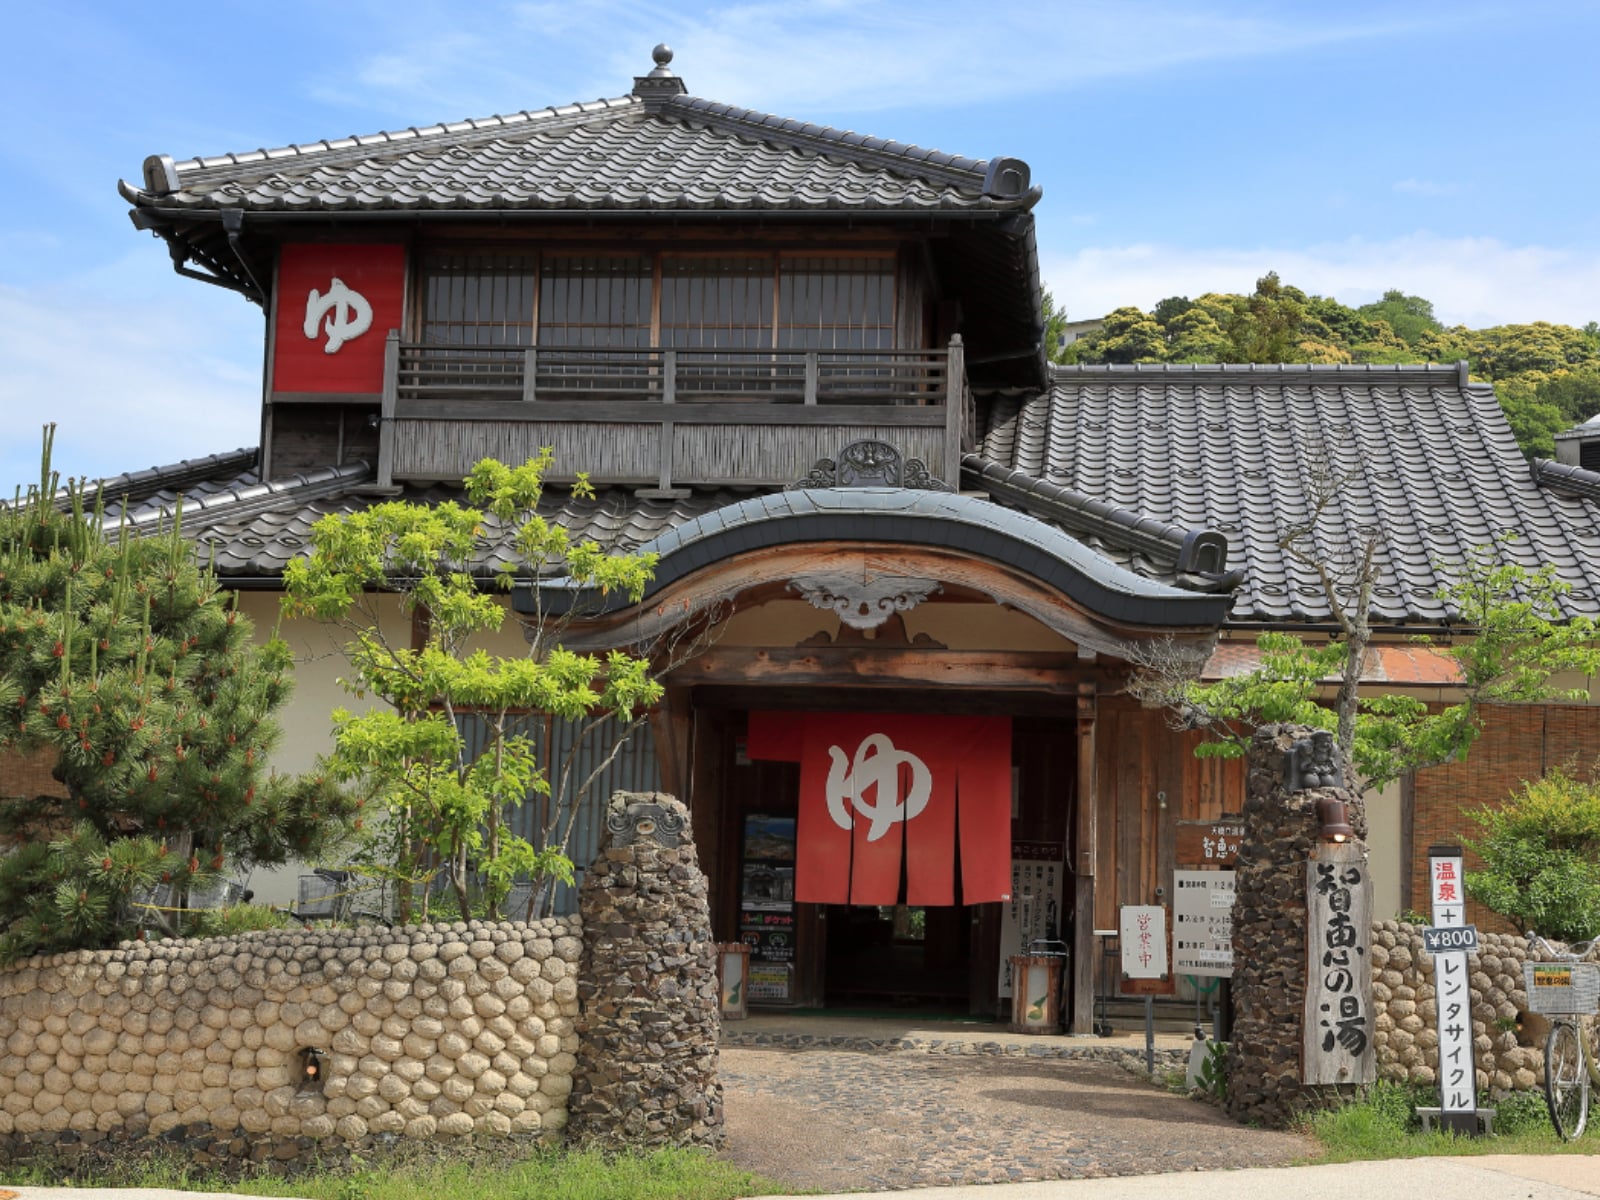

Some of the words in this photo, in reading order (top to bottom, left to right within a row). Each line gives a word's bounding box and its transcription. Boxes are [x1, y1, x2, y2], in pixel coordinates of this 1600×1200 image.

[303, 277, 374, 354] ゆ
[825, 732, 932, 842] ゆ
[1435, 862, 1456, 903] 温泉
[1136, 913, 1152, 969] 営業中
[1316, 863, 1367, 1058] 智恵の湯
[1427, 930, 1474, 947] ¥800
[1444, 958, 1469, 1109] レンタサイクル
